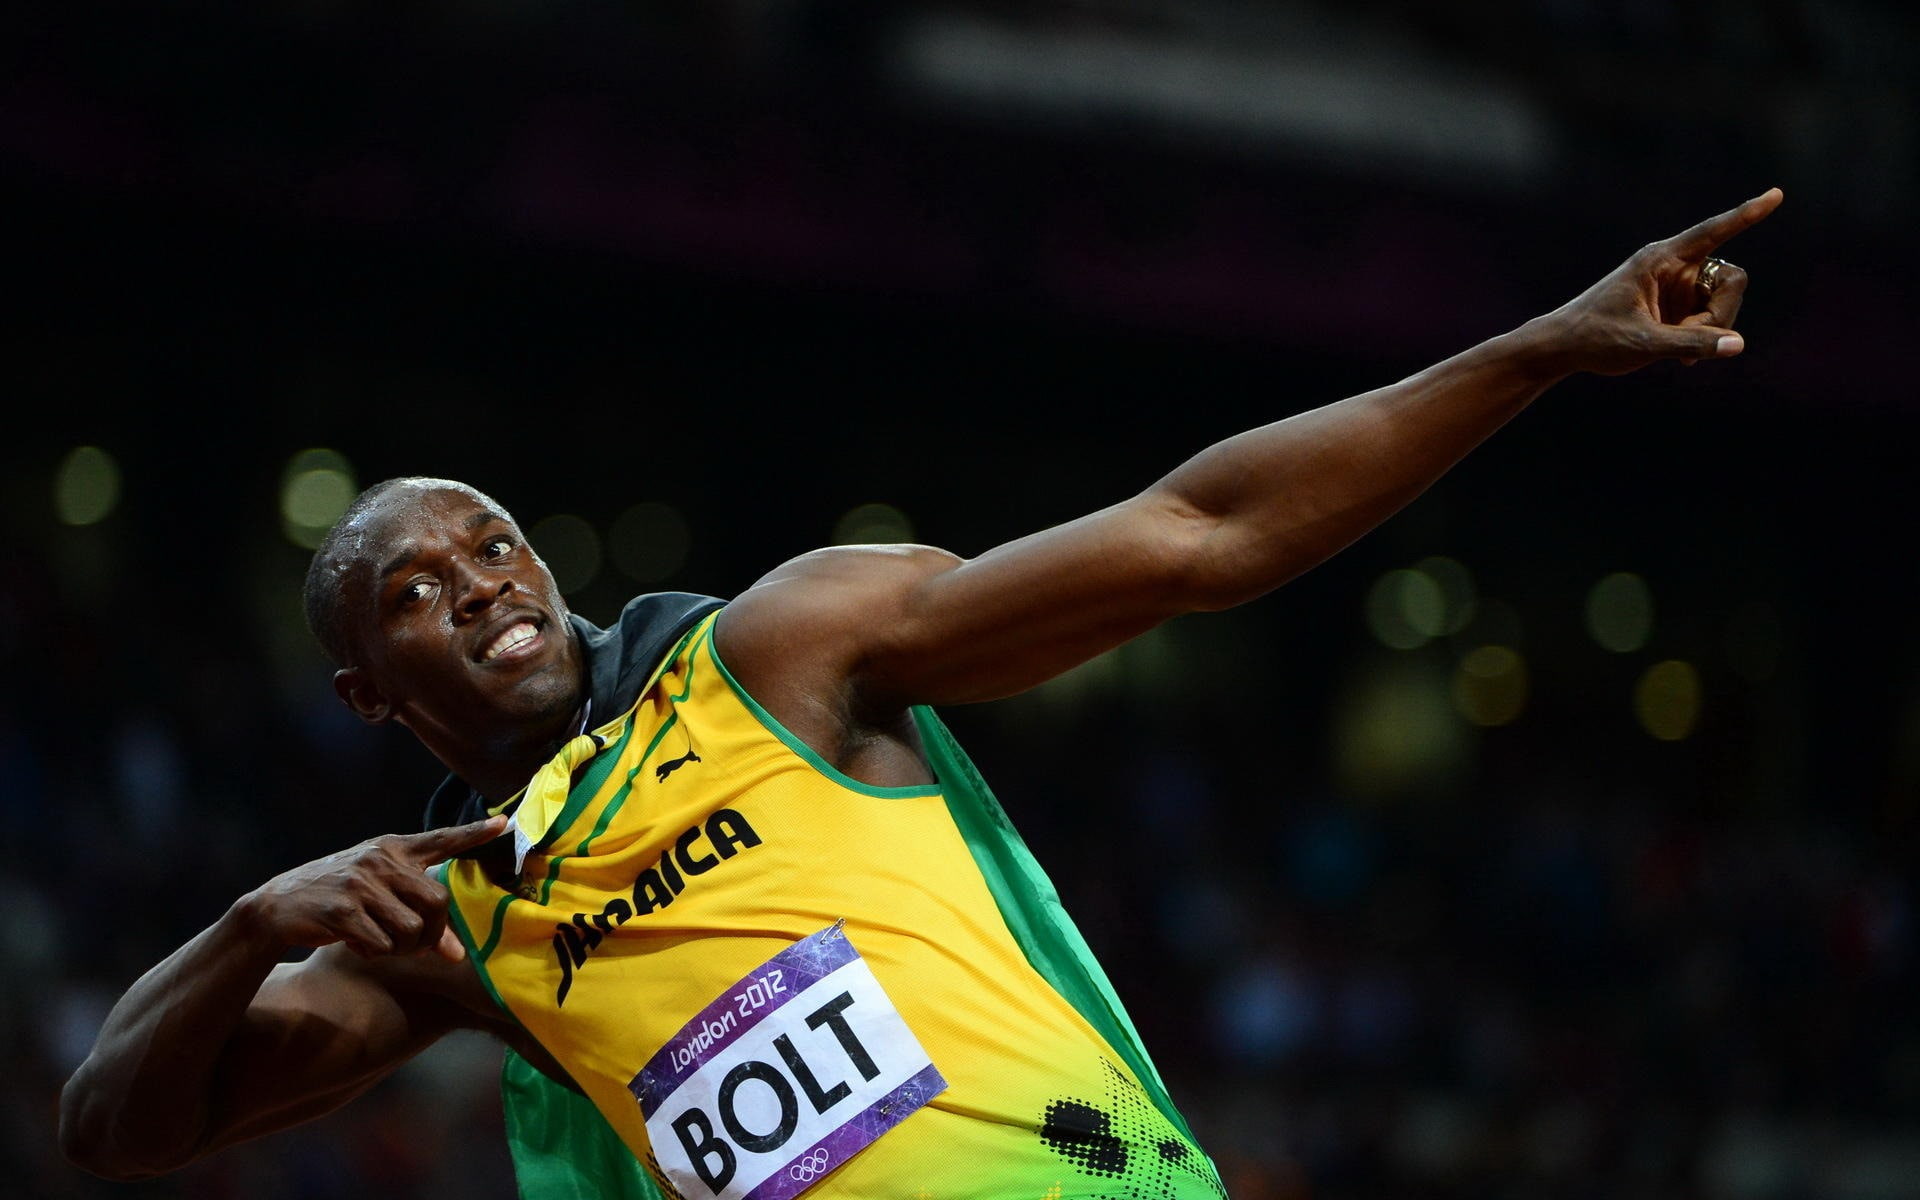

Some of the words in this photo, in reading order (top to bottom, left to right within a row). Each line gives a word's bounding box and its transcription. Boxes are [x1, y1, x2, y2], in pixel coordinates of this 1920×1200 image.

[671, 1011, 737, 1074] London
[734, 969, 787, 1018] 2012
[671, 990, 881, 1197] BOLT
